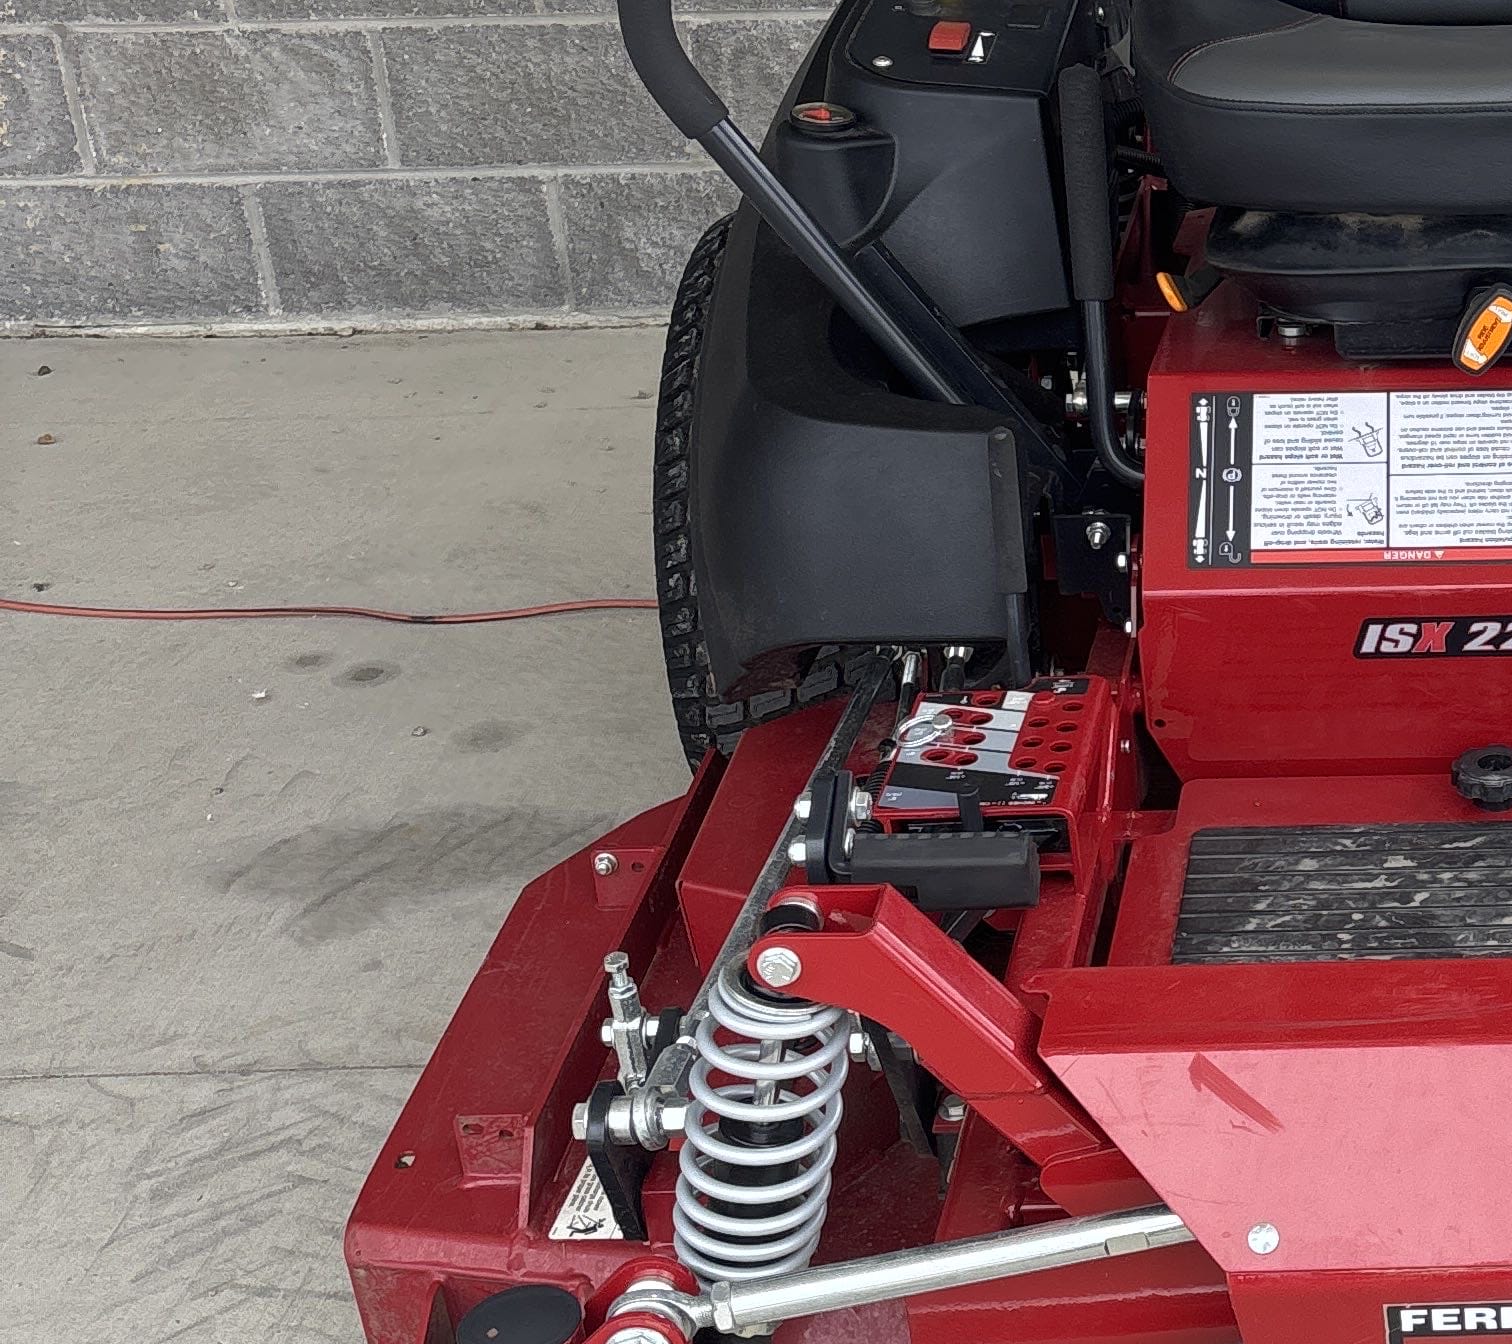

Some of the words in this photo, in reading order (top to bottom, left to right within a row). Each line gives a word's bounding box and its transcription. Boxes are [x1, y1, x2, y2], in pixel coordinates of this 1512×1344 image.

[1196, 468, 1206, 478] N
[1384, 550, 1431, 560] DANGER
[1360, 622, 1454, 653] ISX
